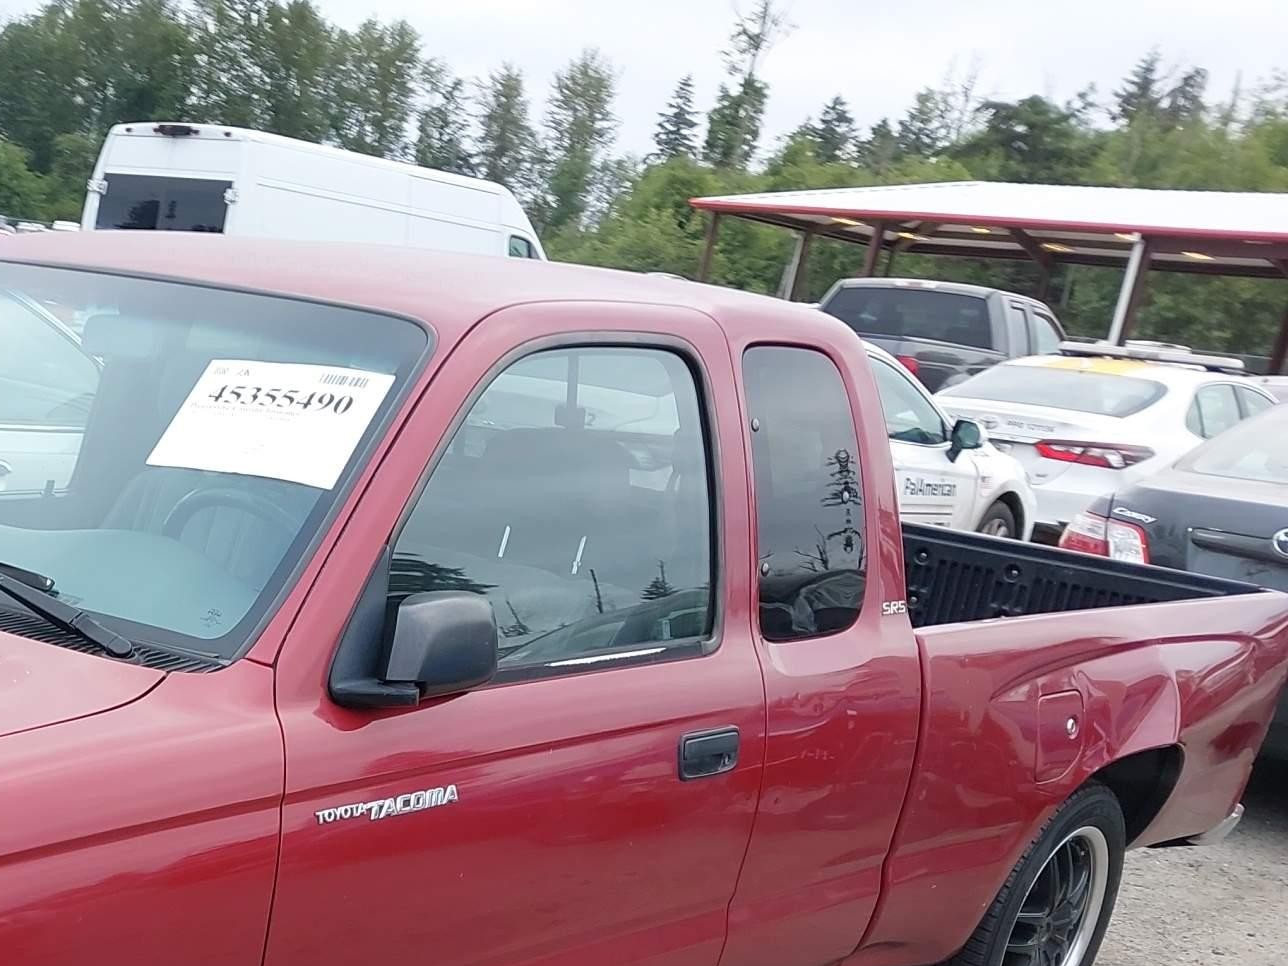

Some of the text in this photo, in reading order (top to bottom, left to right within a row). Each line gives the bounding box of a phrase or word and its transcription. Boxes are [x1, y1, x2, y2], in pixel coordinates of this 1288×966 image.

[208, 385, 354, 415] 45355490
[882, 600, 907, 615] SR5
[315, 785, 458, 824] TOYOTA TACOMA
